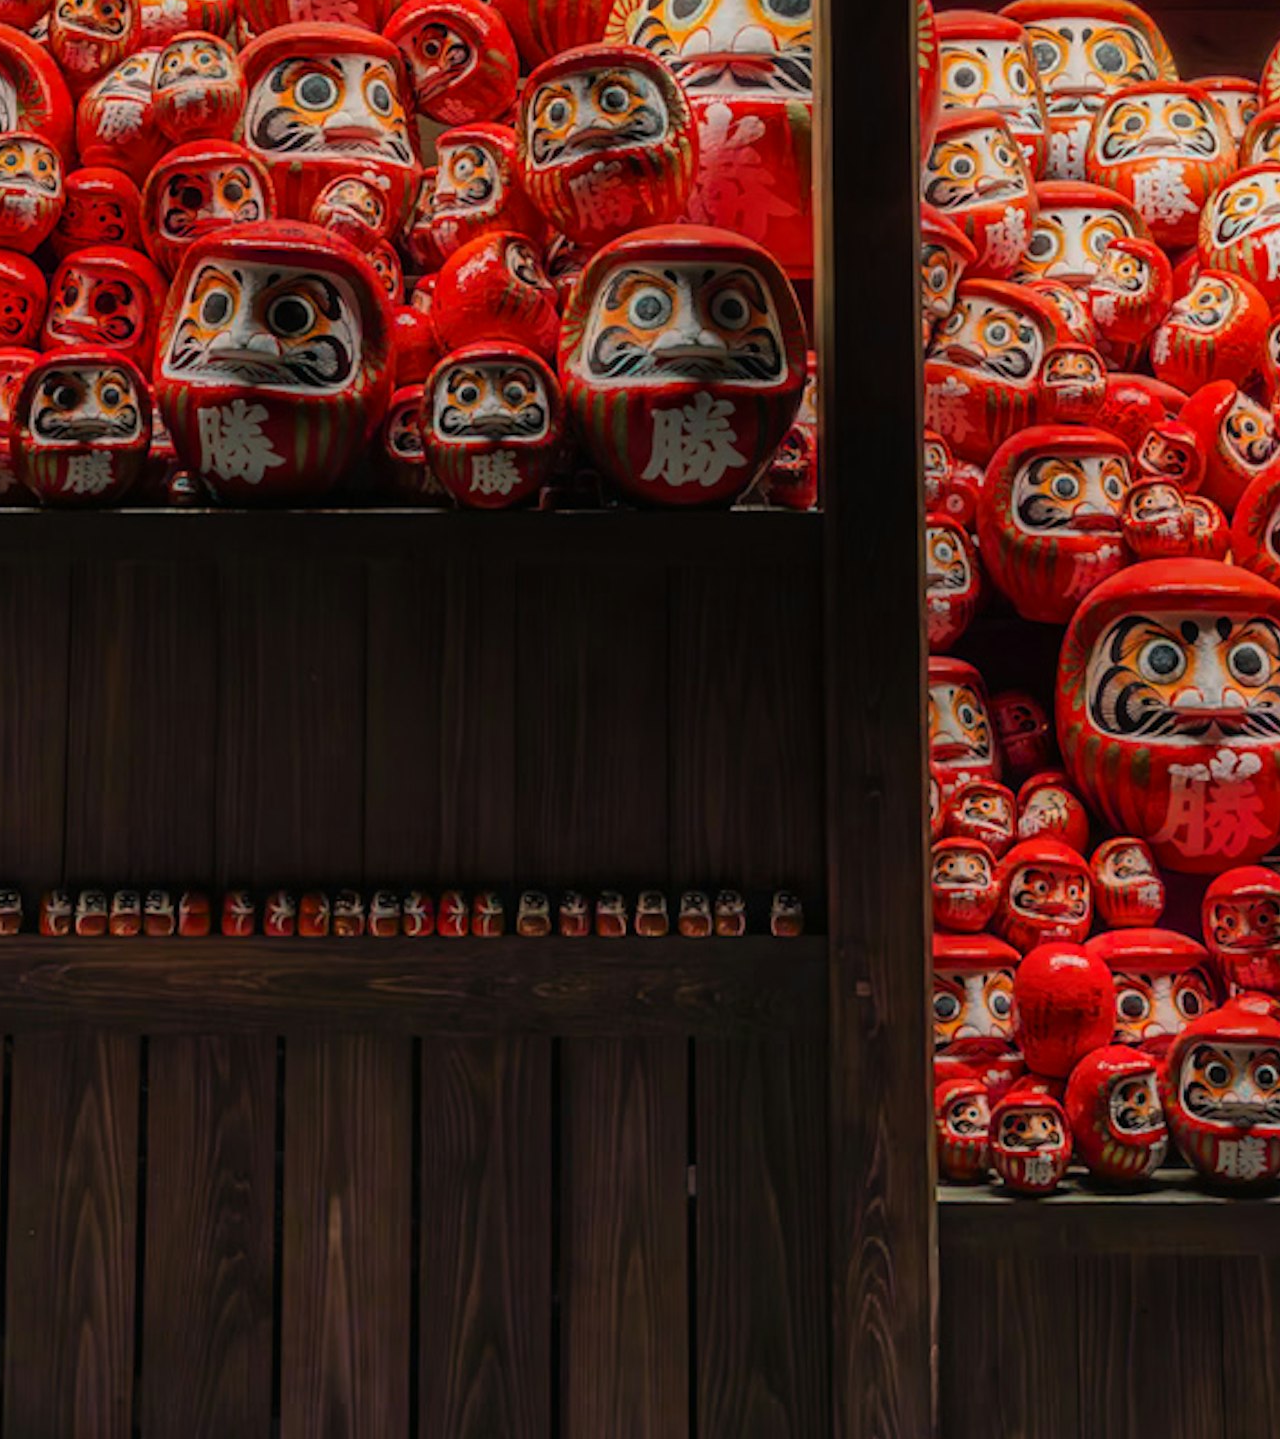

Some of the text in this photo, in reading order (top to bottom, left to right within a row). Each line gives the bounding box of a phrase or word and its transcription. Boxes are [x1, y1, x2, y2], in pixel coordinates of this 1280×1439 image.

[99, 102, 145, 142] 勝
[1134, 158, 1196, 224] 勝
[199, 400, 285, 484] 勝
[647, 393, 747, 486] 勝
[61, 450, 115, 493] 勝
[470, 452, 522, 494] 勝
[1160, 749, 1272, 858] 勝
[1218, 1137, 1267, 1180] 勝
